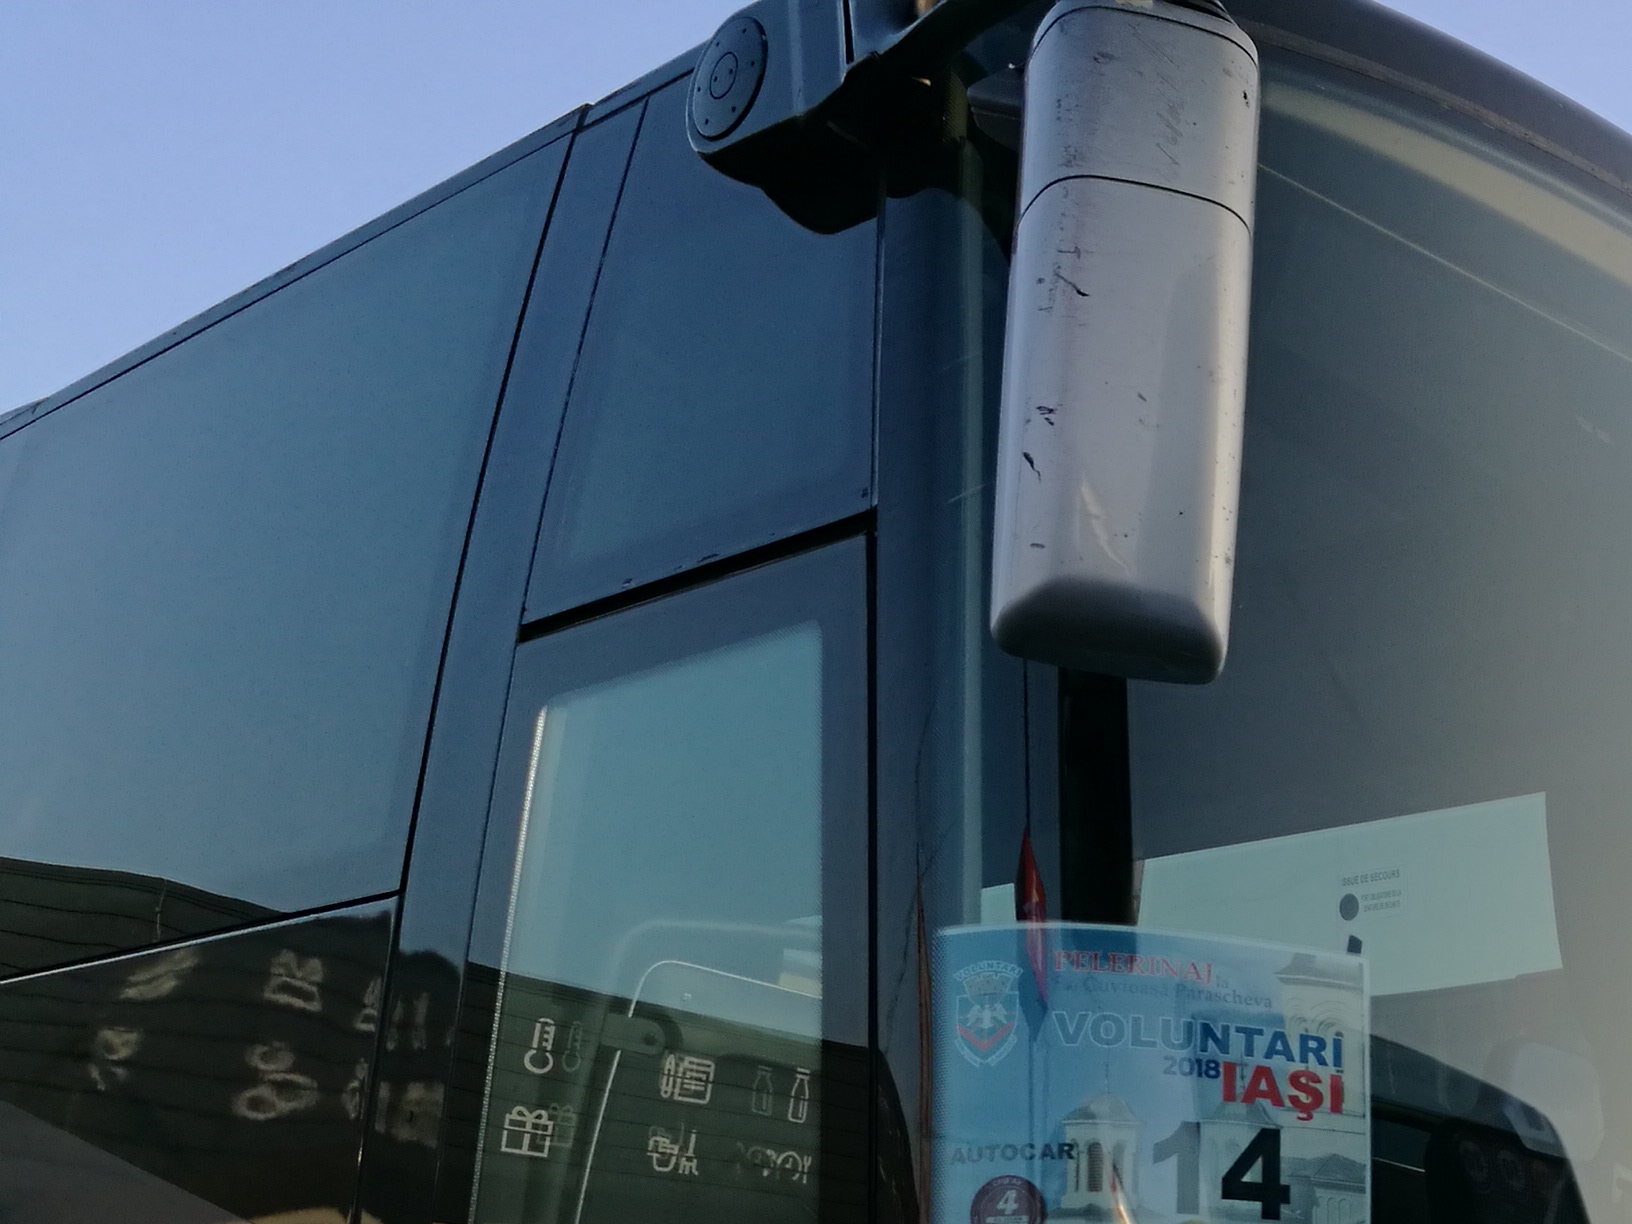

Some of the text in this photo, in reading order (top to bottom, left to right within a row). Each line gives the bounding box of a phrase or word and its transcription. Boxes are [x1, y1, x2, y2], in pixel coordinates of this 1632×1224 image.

[1370, 869, 1400, 882] SECOURS
[954, 961, 1023, 981] VOLUNTARI
[1053, 951, 1214, 987] PELERINAJ
[1175, 983, 1273, 1009] Parascheva
[1052, 1010, 1344, 1069] VOLUNTARI
[1162, 1056, 1222, 1080] 2018
[950, 1142, 1076, 1165] AUTOCAR
[1152, 1121, 1291, 1221] 14
[996, 1189, 1020, 1215] 4
